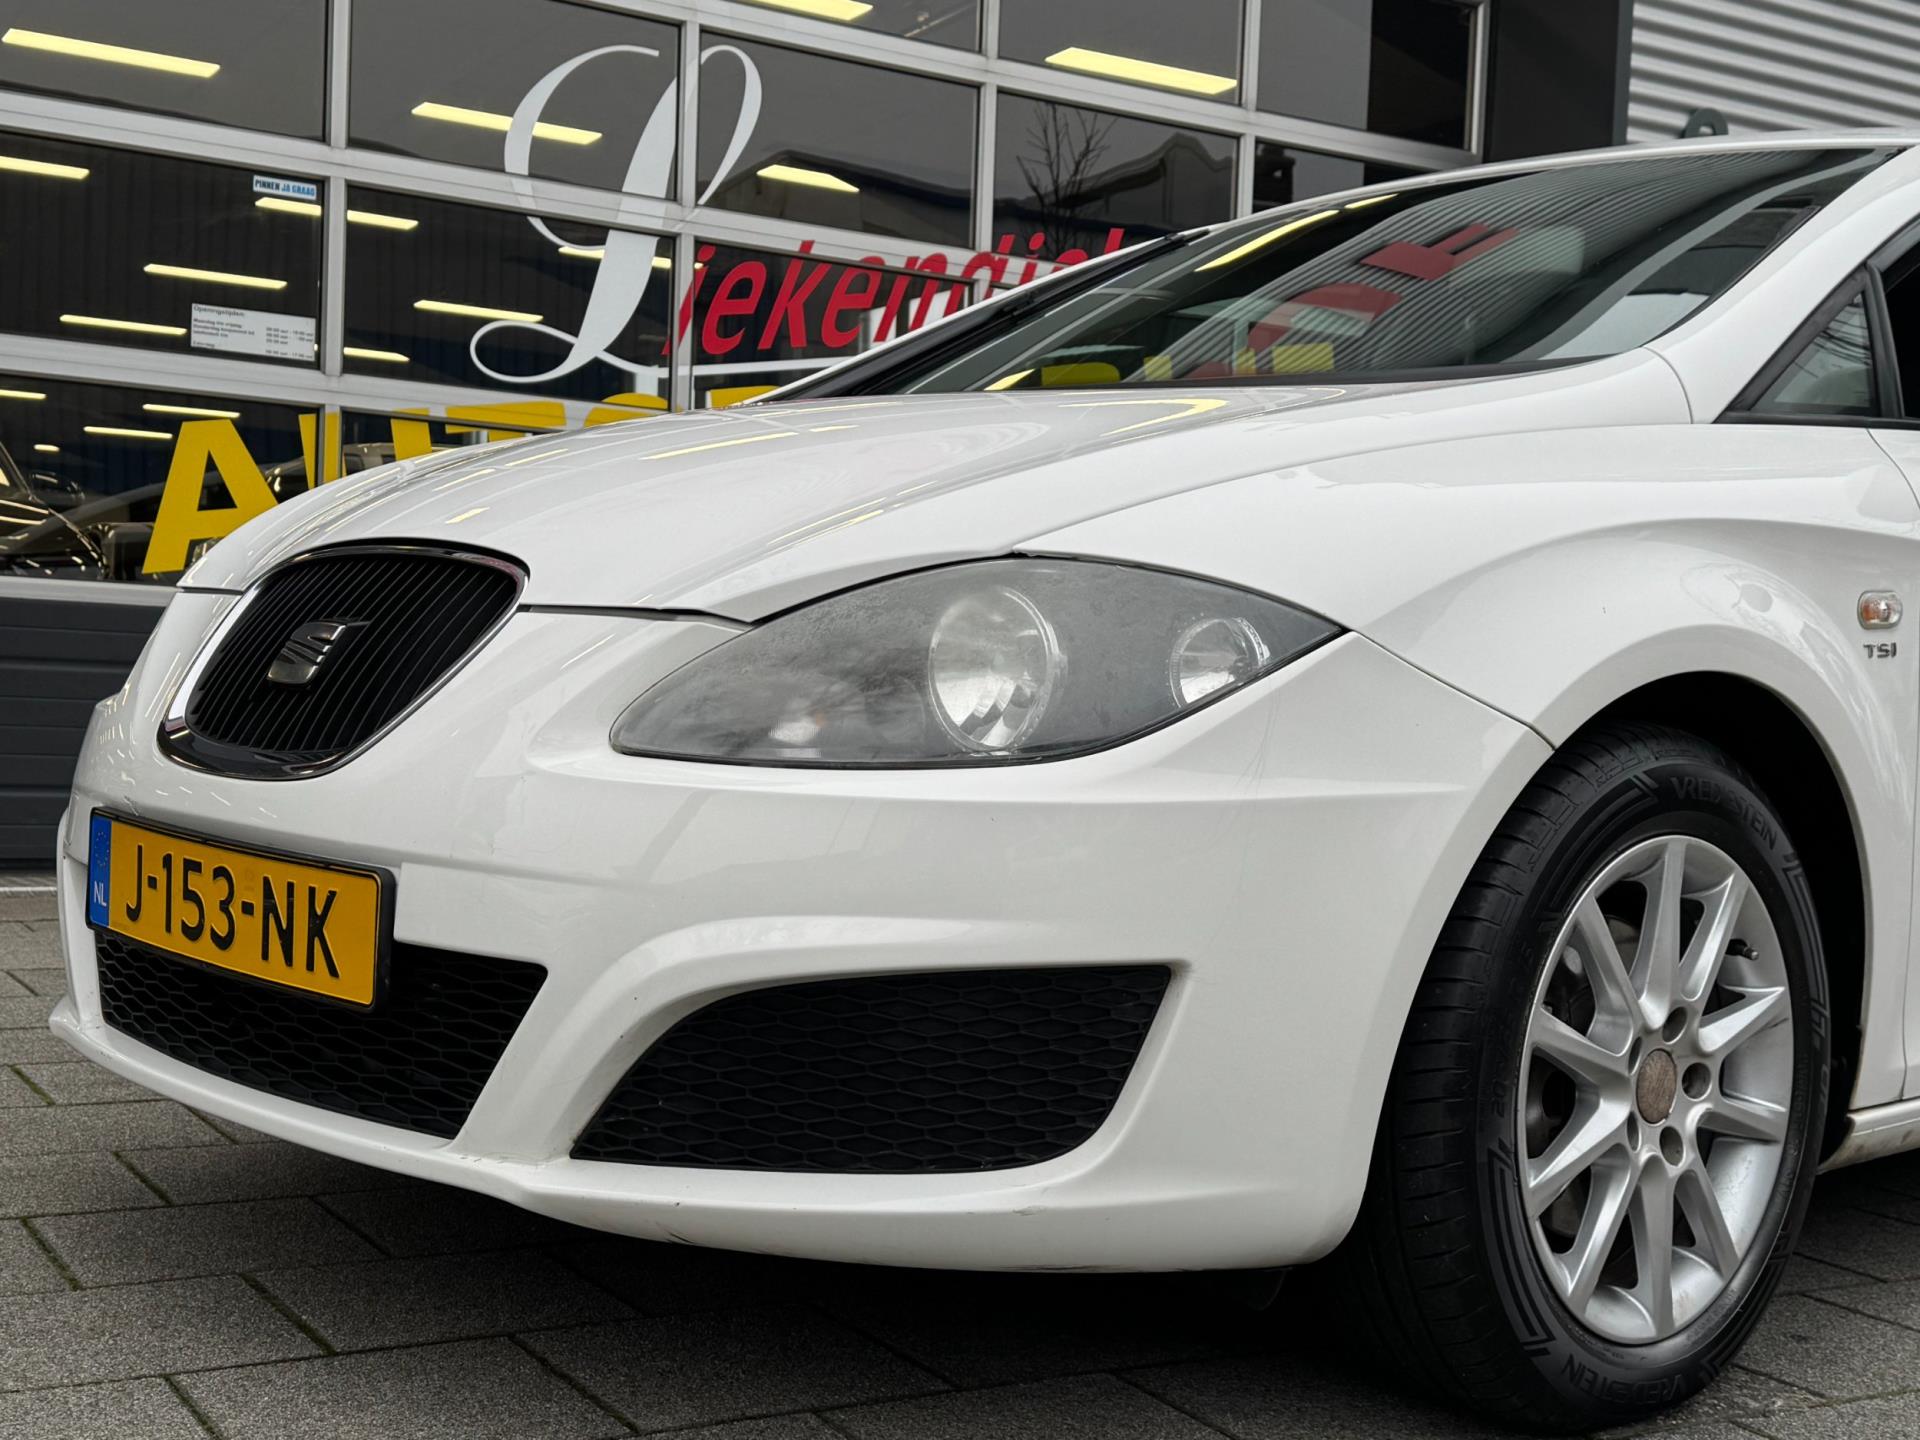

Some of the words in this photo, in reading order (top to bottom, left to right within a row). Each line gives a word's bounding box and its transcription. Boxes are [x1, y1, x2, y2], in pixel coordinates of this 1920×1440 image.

[255, 178, 280, 191] PINNEN
[281, 183, 291, 193] JA
[1863, 642, 1897, 659] TSI
[93, 880, 107, 907] NL
[126, 844, 340, 979] J-153-NK
